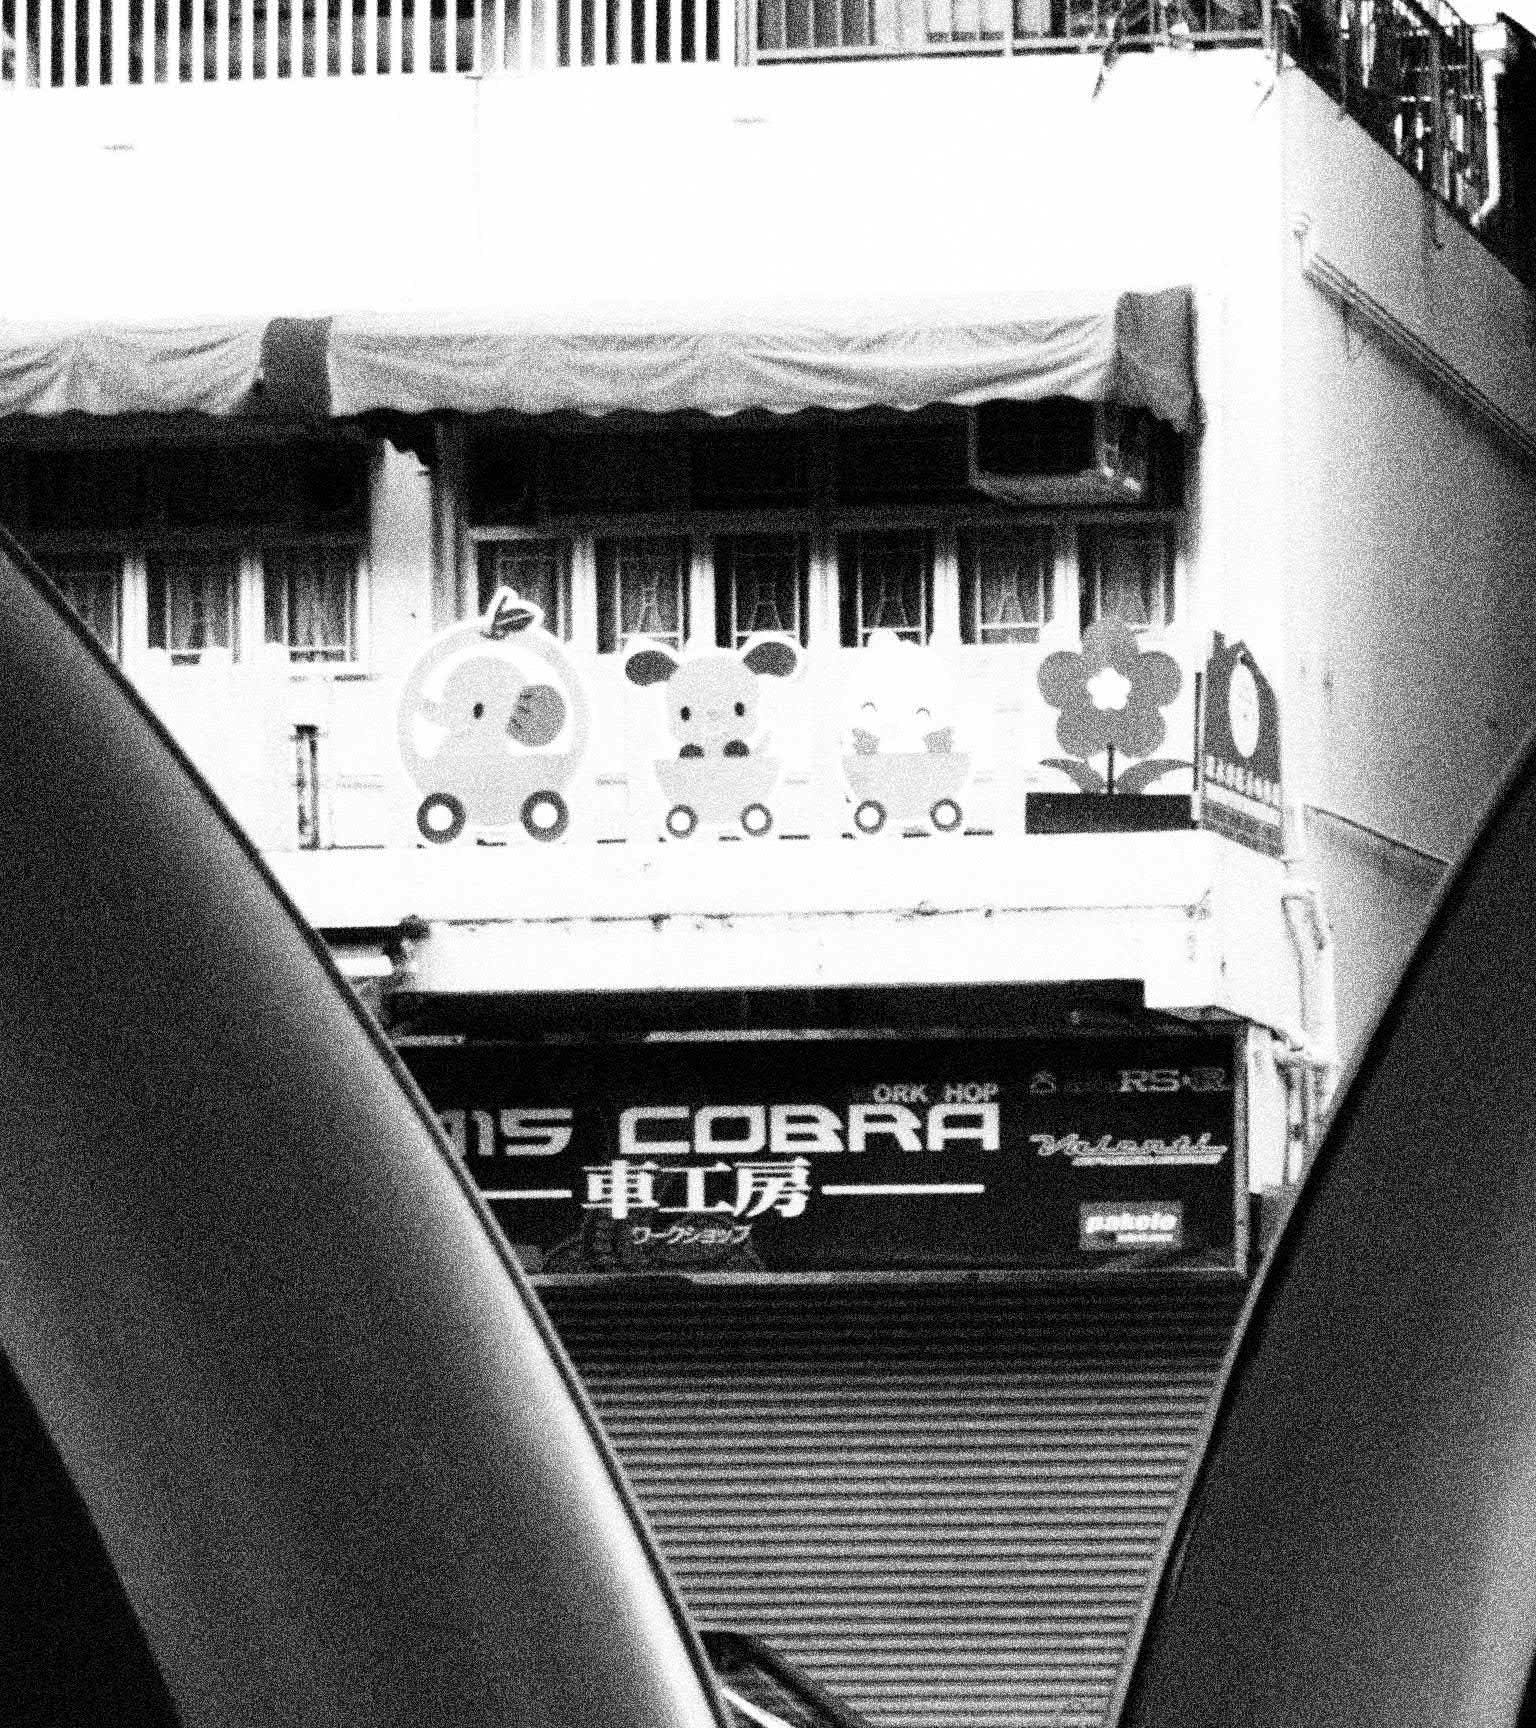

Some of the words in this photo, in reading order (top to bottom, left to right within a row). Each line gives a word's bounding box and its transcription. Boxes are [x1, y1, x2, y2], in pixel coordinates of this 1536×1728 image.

[617, 1105, 999, 1154] COBRA
[582, 1159, 810, 1220] 車工房
